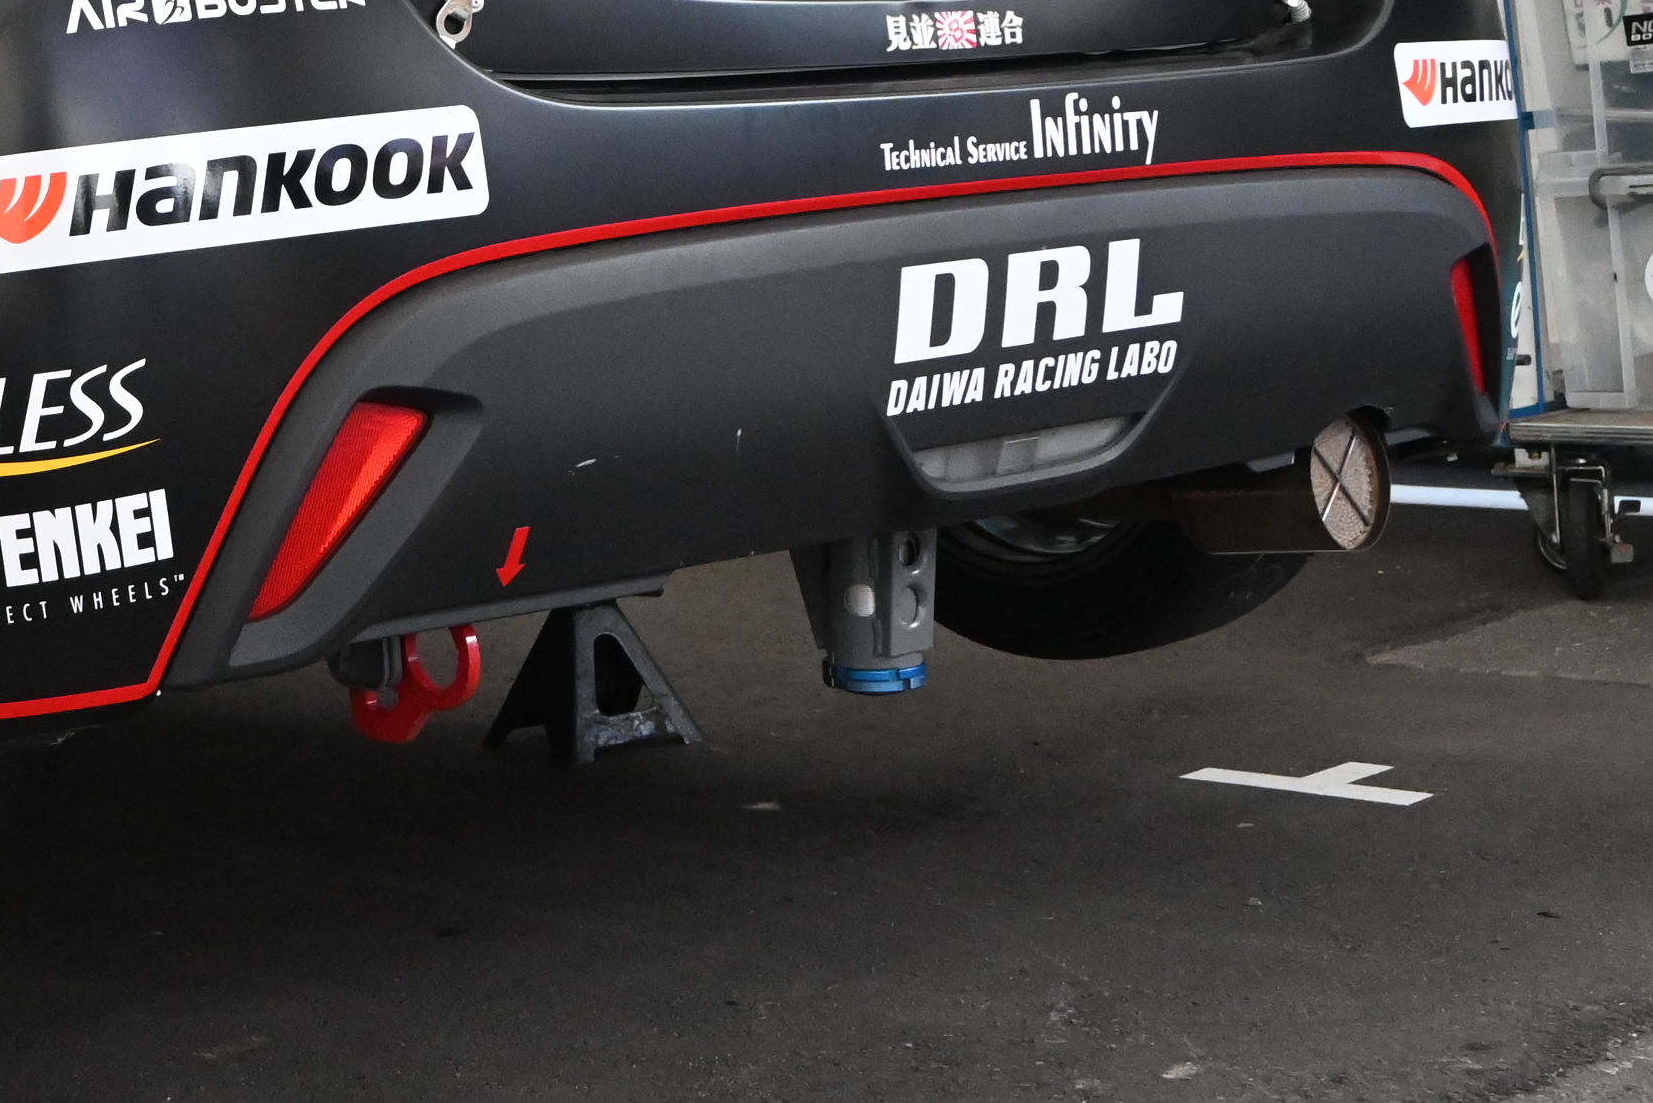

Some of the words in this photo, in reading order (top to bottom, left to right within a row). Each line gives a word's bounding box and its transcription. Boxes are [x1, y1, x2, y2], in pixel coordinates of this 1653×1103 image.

[886, 13, 937, 52] 見並
[976, 10, 1024, 47] 連合
[1440, 59, 1514, 104] Hanko
[894, 238, 1184, 365] DRL
[886, 367, 985, 417] DAIWA
[993, 349, 1101, 399] RACING
[1106, 340, 1178, 381] LABO
